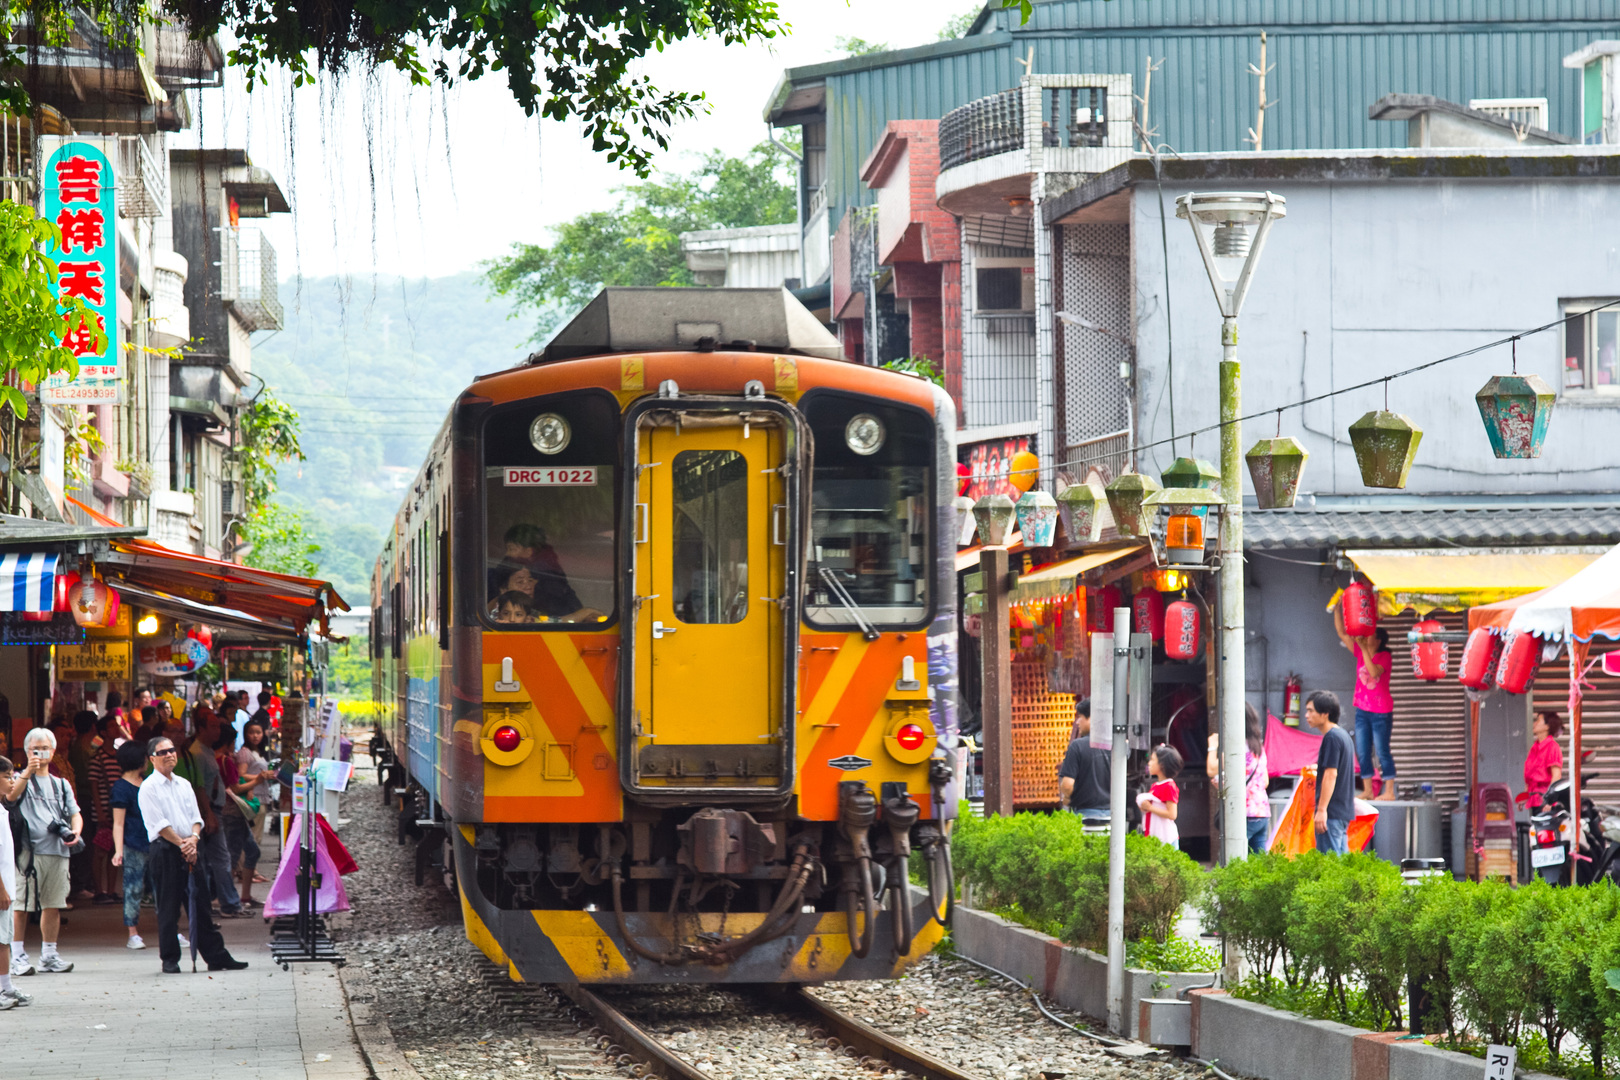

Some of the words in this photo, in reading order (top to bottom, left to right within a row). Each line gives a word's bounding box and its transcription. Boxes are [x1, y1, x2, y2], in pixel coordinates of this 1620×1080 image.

[49, 388, 116, 399] TEL:24958396
[509, 470, 541, 483] DRC
[547, 470, 593, 483] 1022
[1490, 1054, 1509, 1080] R=
